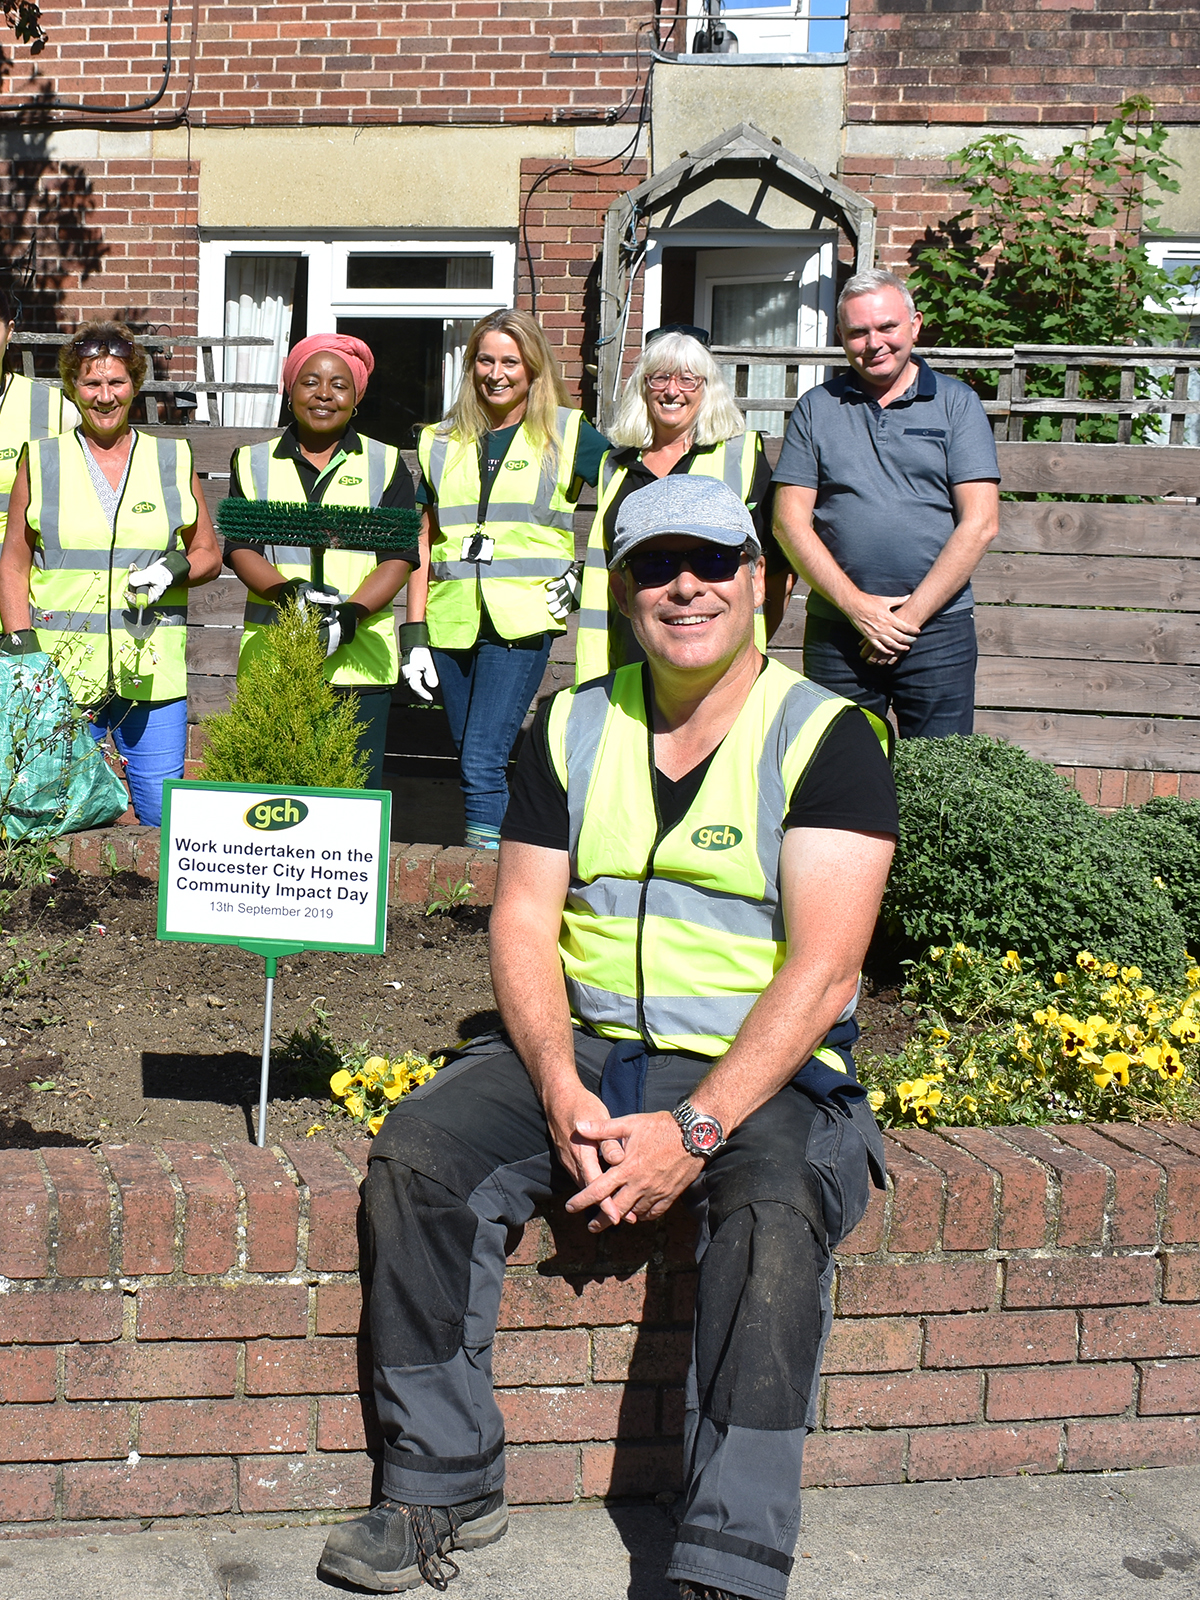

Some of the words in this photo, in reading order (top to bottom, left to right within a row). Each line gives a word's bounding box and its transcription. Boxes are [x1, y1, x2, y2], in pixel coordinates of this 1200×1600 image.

[507, 460, 526, 470] gch
[341, 476, 360, 486] gch
[134, 502, 154, 514] gch
[254, 799, 300, 829] gch
[697, 826, 736, 848] gch
[175, 837, 218, 854] Work
[223, 842, 315, 860] undertaken
[321, 849, 342, 861] on
[347, 848, 374, 863] the
[178, 857, 269, 876] Gloucester
[273, 862, 306, 882] City
[310, 865, 369, 883] Homes
[176, 876, 271, 899] Community
[276, 883, 332, 901] Impact
[337, 886, 369, 905] Day
[209, 901, 234, 913] 13th
[237, 902, 301, 917] September
[304, 906, 334, 919] 2019
